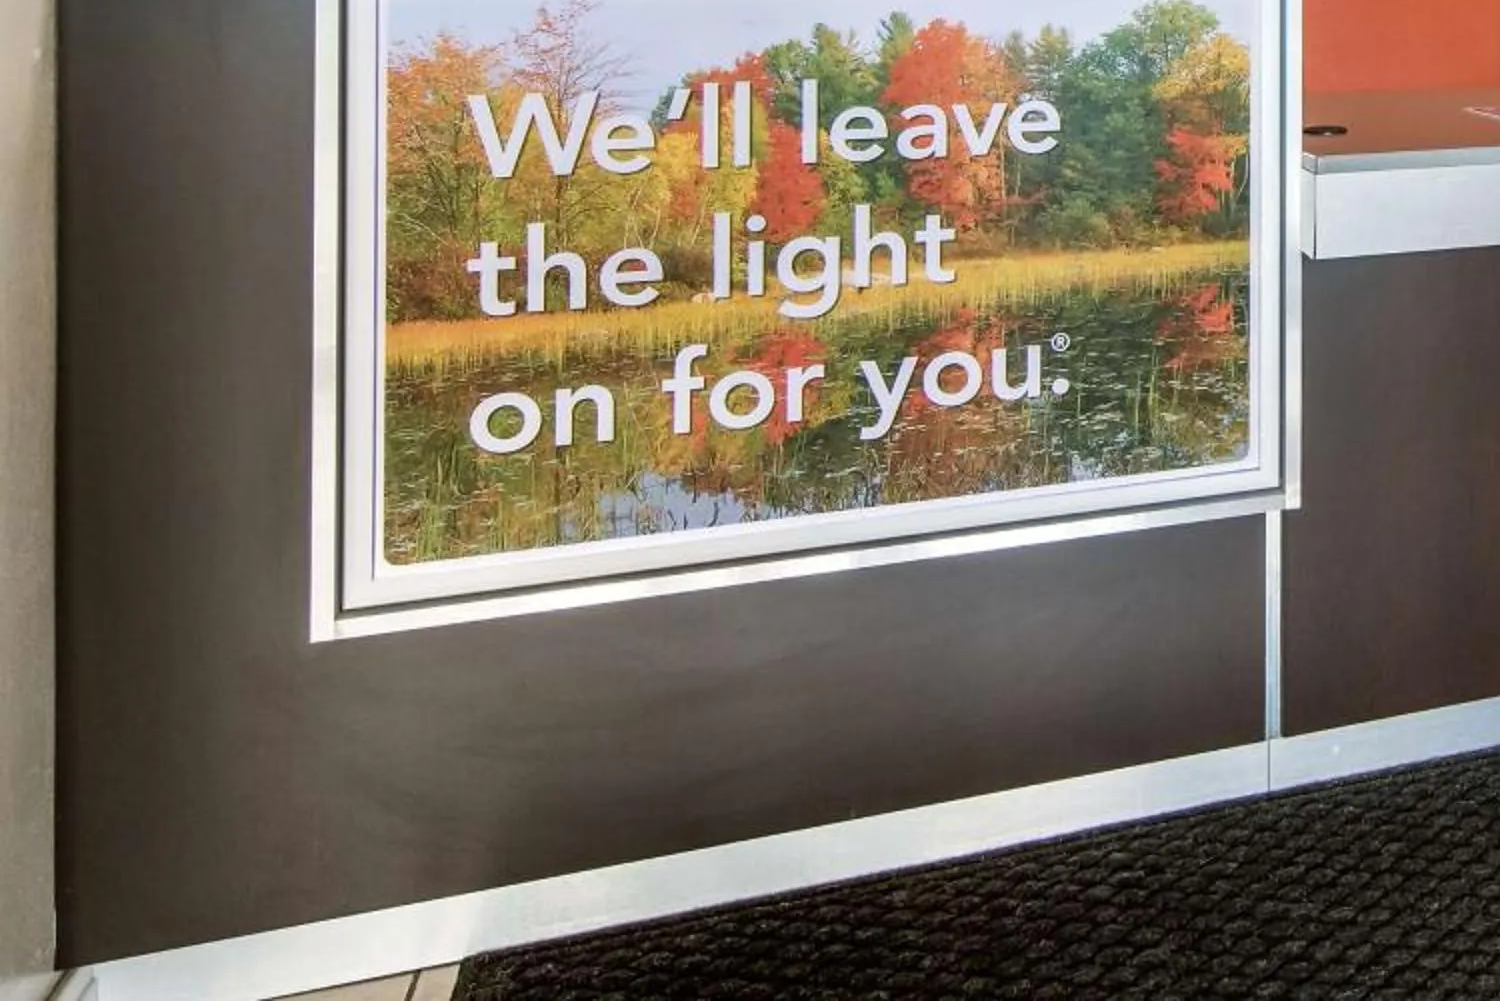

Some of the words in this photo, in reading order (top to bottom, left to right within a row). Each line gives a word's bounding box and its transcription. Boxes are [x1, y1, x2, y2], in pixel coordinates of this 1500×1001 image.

[467, 80, 754, 177] We'll
[801, 78, 1062, 164] leave
[467, 221, 665, 317] the
[712, 203, 957, 320] light
[468, 382, 616, 455] on
[661, 343, 825, 436] for
